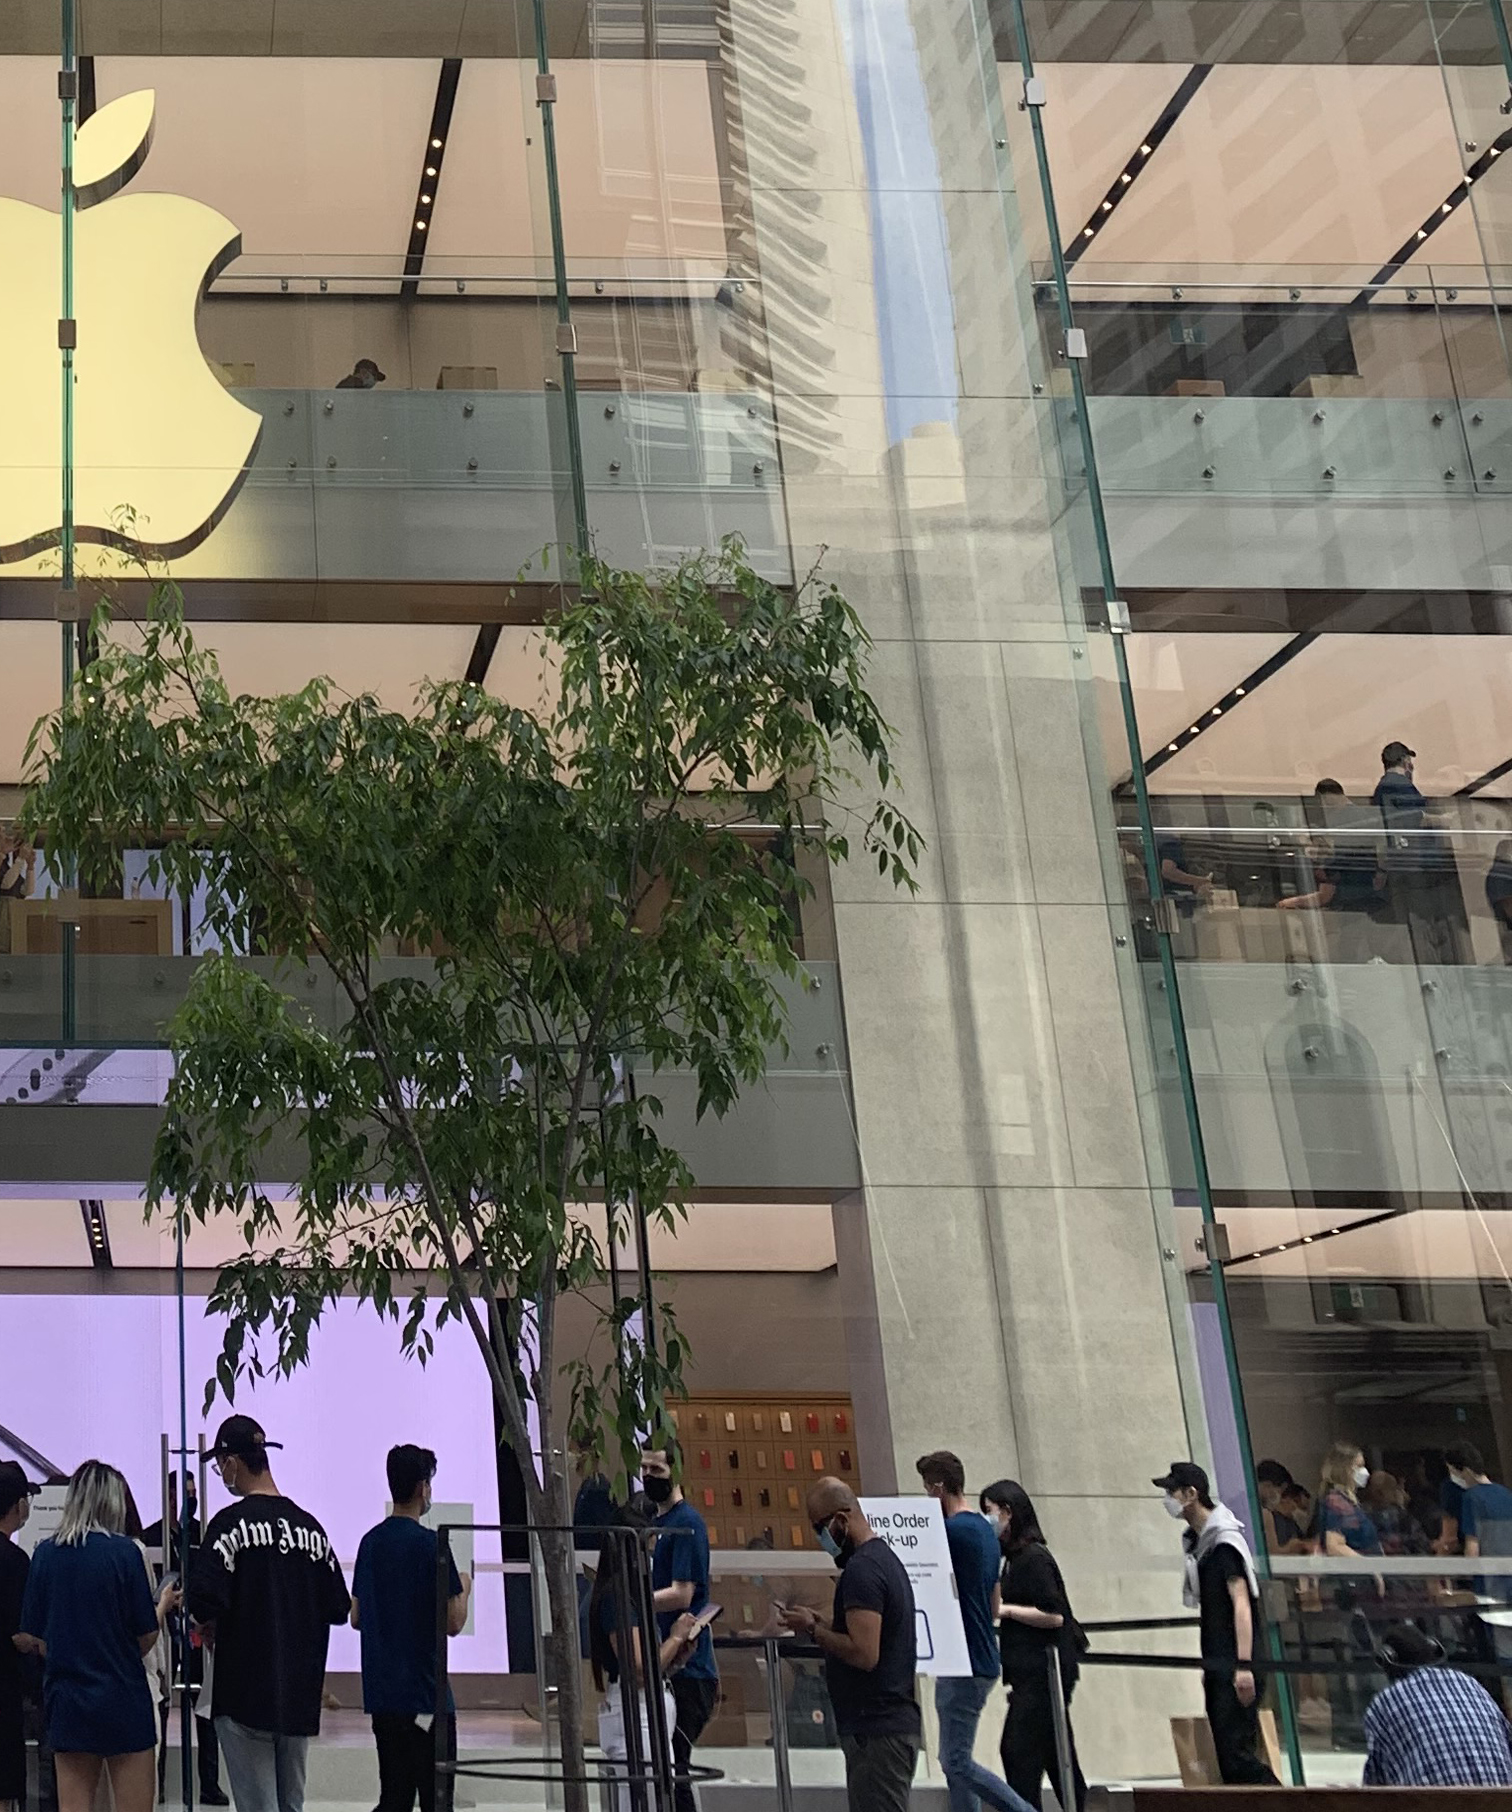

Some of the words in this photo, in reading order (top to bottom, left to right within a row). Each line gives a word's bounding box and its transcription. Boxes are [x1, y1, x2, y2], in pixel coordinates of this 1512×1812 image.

[866, 1513, 890, 1529] line
[892, 1513, 930, 1529] Order
[277, 1517, 335, 1573] Ang
